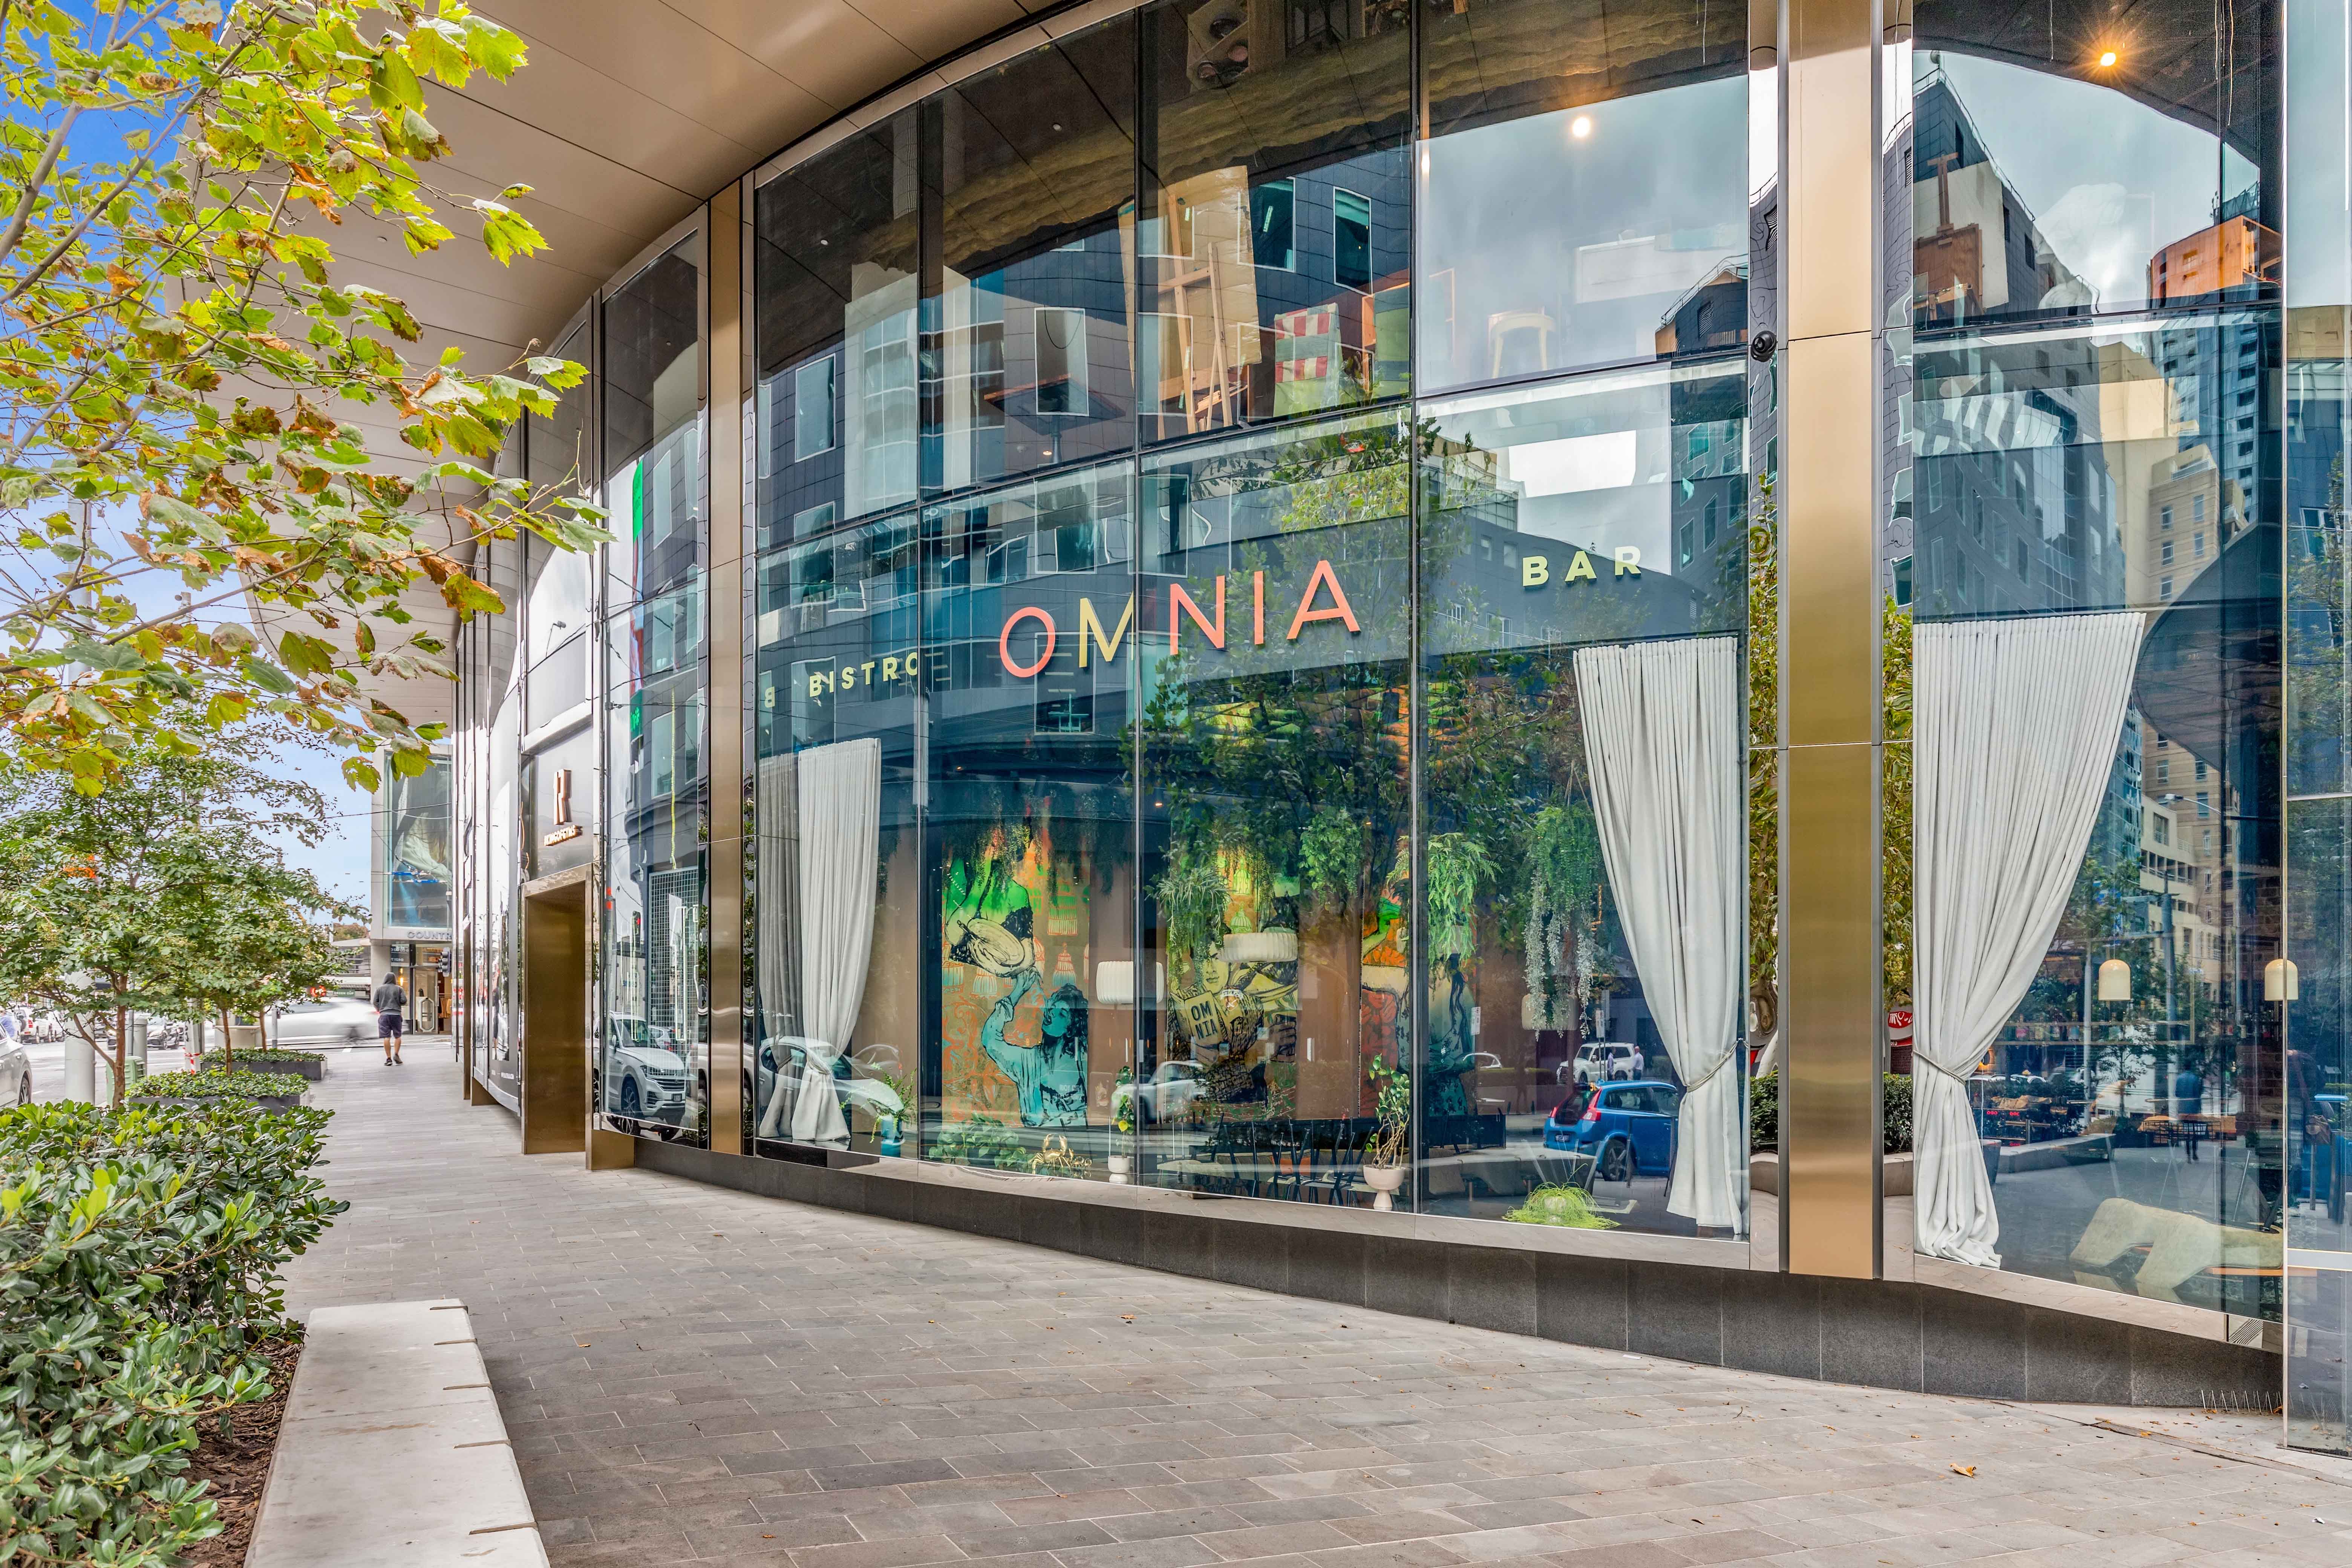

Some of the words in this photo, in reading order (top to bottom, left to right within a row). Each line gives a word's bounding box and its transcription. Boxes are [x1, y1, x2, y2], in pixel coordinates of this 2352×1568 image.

[1522, 545, 1642, 587] BAR
[999, 559, 1361, 678] OMNIA
[809, 652, 918, 697] BISTRO
[1191, 1000, 1213, 1021] OM
[1195, 1018, 1218, 1040] NIA
